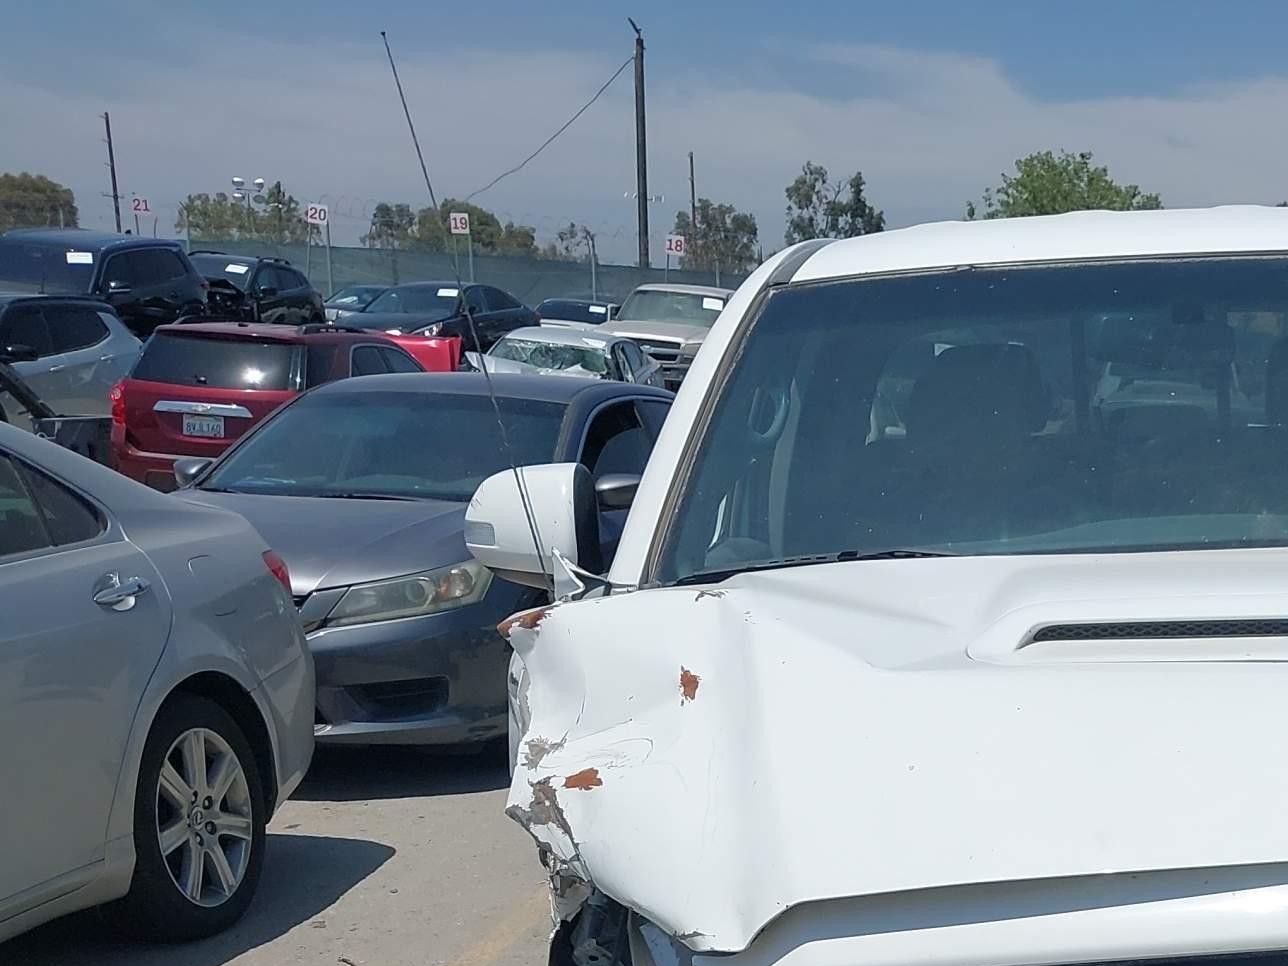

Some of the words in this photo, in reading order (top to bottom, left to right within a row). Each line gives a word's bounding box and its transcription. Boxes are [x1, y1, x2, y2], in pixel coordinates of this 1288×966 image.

[133, 198, 150, 211] 21
[309, 206, 327, 221] 20
[452, 216, 468, 230] 19
[666, 239, 683, 252] 18
